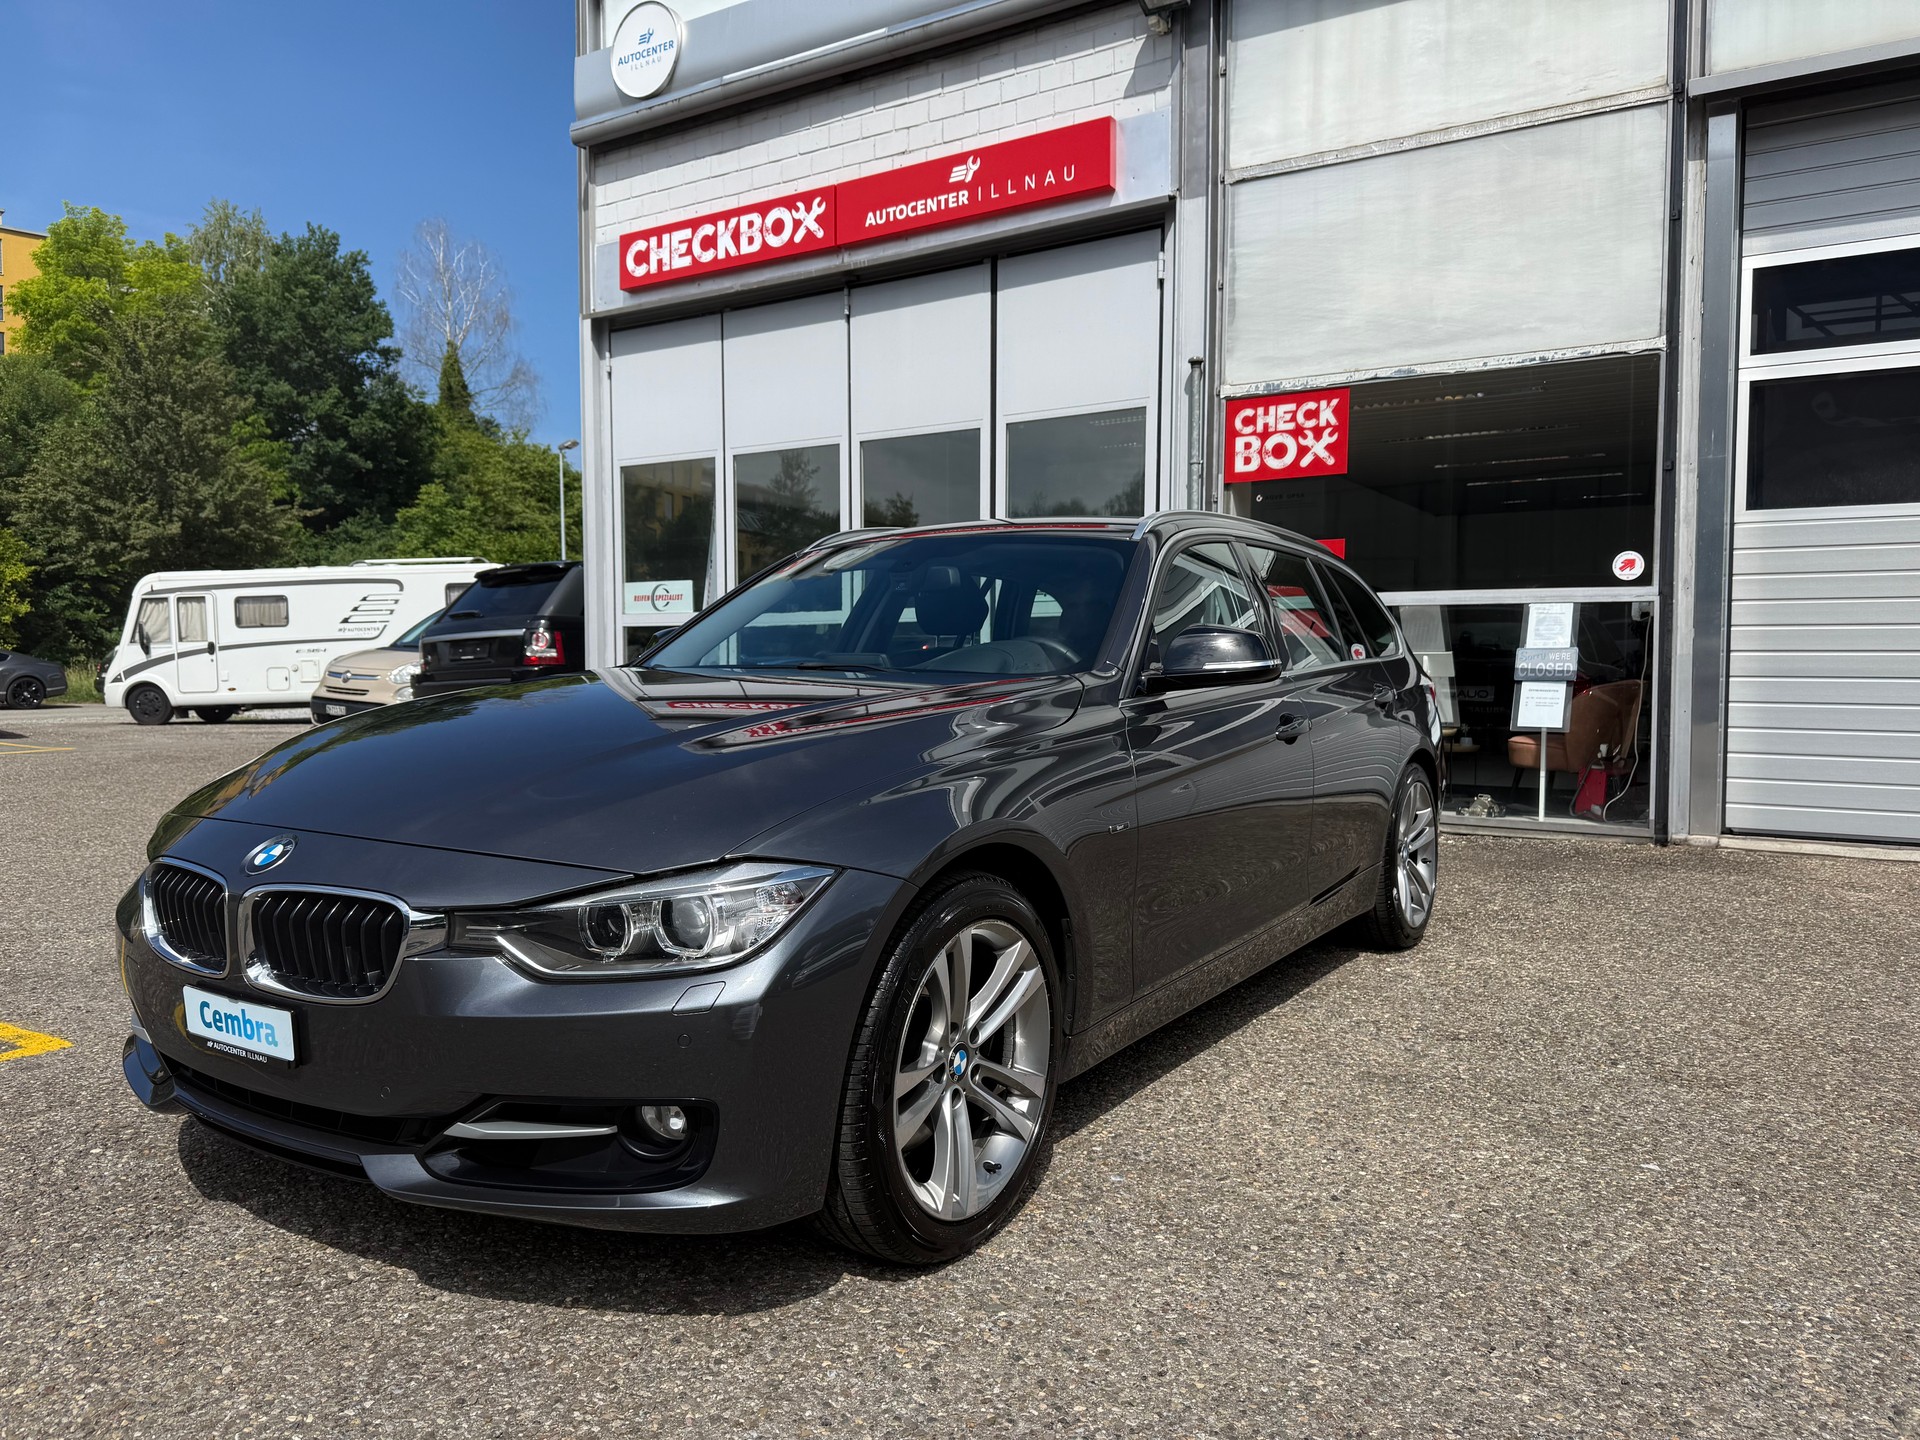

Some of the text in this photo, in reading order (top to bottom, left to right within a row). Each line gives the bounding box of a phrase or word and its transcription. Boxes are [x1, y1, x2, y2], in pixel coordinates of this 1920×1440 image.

[618, 40, 674, 66] AUTOCENTER
[630, 56, 662, 71] ILLNAU
[865, 165, 1075, 228] AUTOCENTER ILLNAU
[626, 197, 826, 277] CHECKBOX
[1234, 398, 1340, 435] CHECK
[1234, 427, 1338, 473] BOX
[1518, 662, 1574, 677] CLOSED
[199, 1000, 279, 1048] Cembra
[213, 1042, 268, 1063] AUTOCENTER ILLNAU
